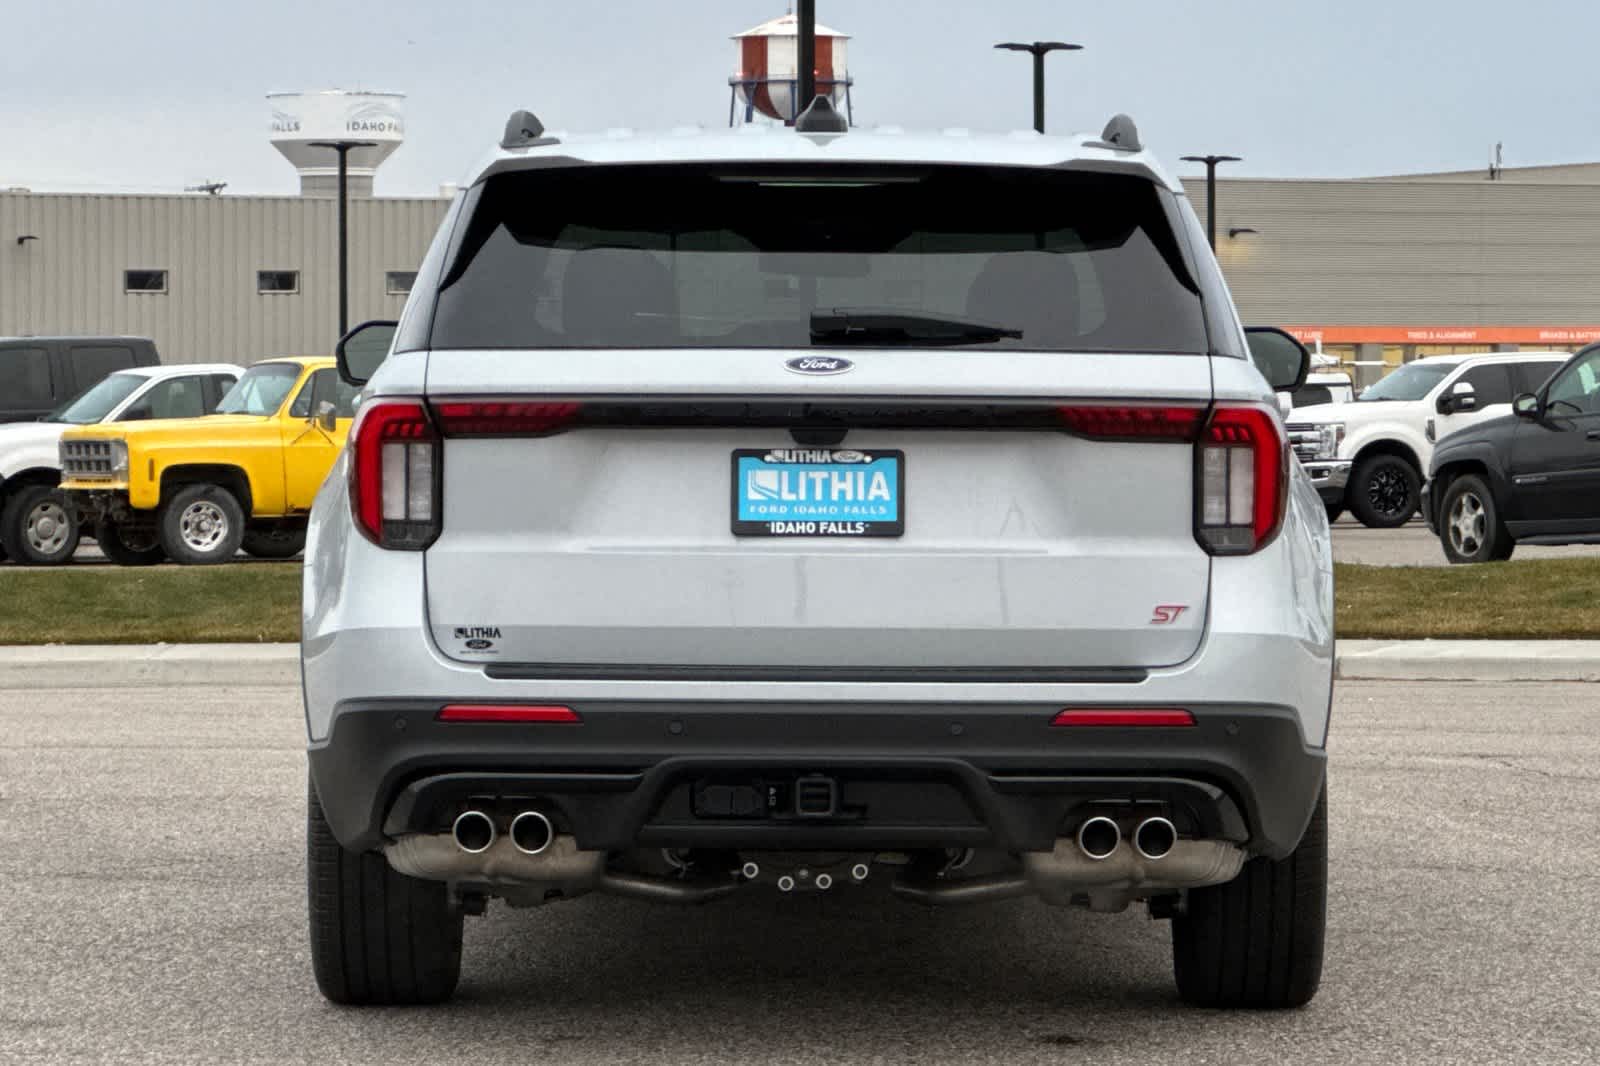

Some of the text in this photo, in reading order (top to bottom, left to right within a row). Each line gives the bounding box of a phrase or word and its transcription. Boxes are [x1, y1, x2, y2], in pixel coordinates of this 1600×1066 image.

[346, 121, 386, 132] IDAHO
[800, 358, 838, 369] Ford
[784, 450, 832, 463] LITHIA
[781, 470, 890, 501] LITHIA
[749, 505, 887, 515] FORD IDAHO FALLS
[770, 521, 865, 534] IDAHO FALLS
[1151, 605, 1190, 625] ST
[465, 627, 502, 638] LITHIA
